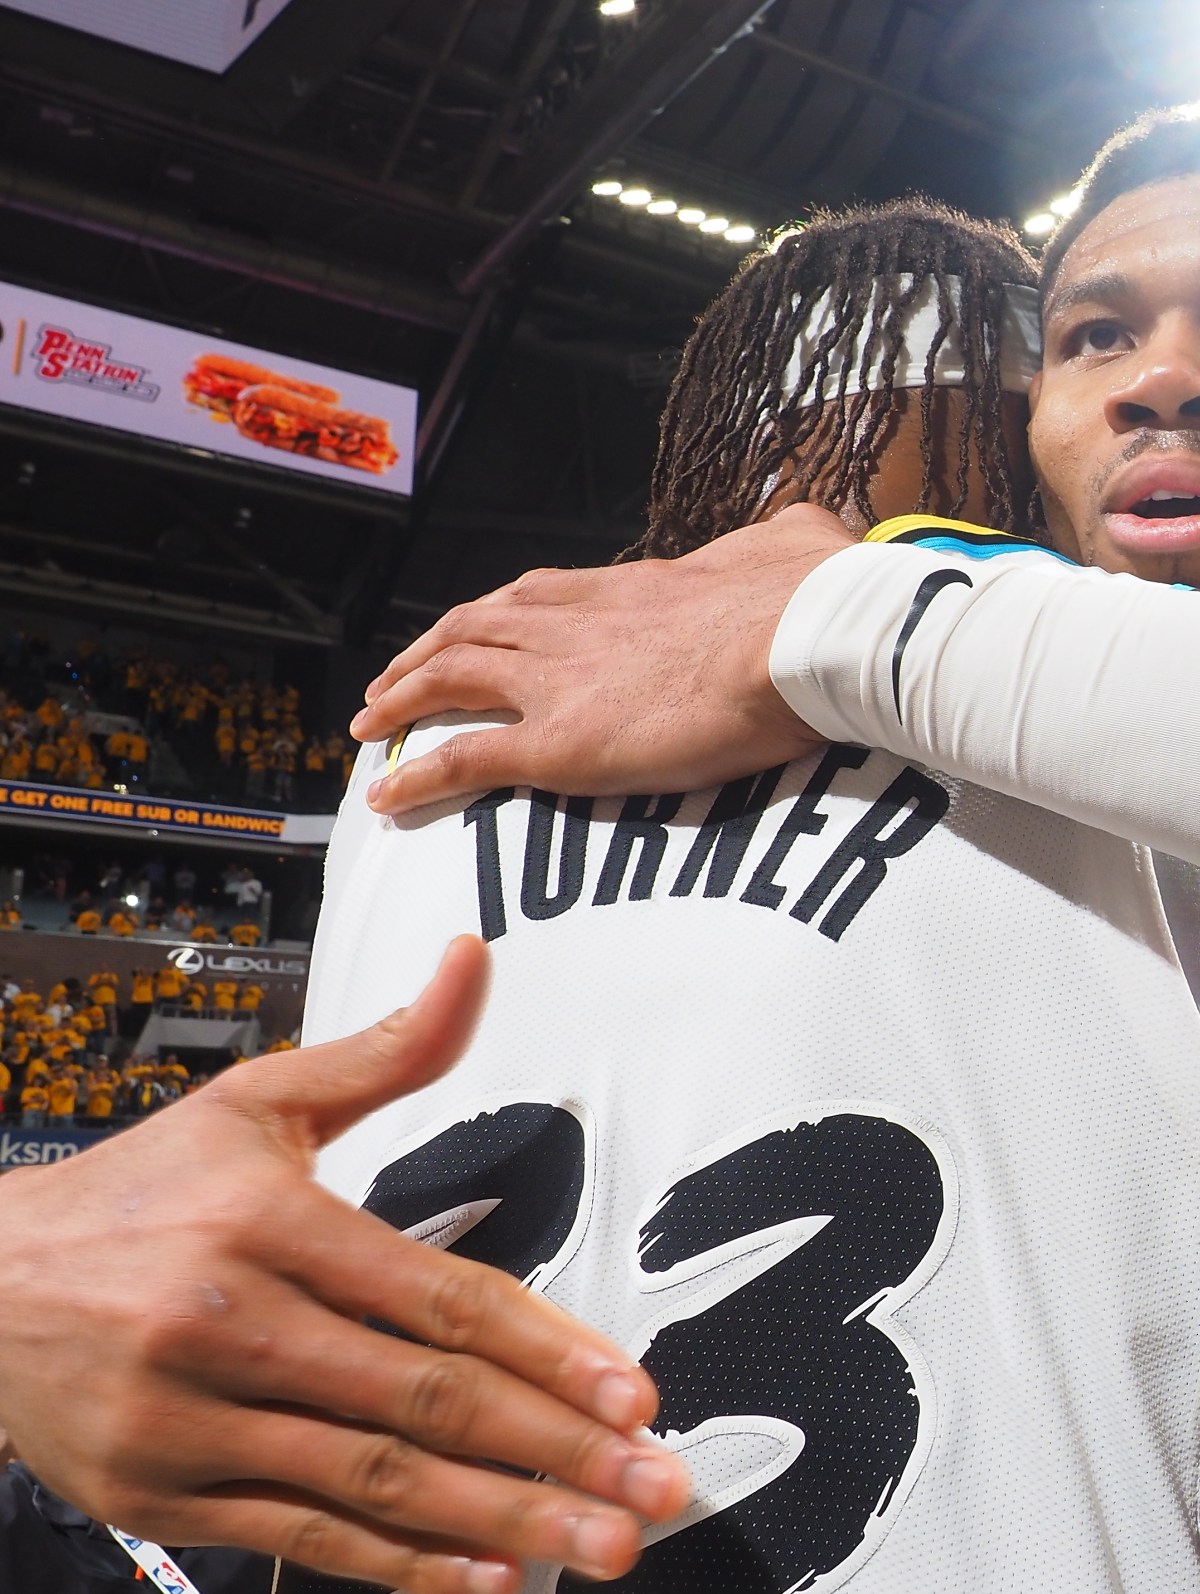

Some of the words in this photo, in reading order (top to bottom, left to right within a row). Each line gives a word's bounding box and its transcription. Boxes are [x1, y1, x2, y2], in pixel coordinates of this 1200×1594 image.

[11, 789, 48, 807] GET
[50, 794, 88, 812] ONE
[91, 799, 134, 817] FREE
[136, 804, 171, 821] SUB
[174, 808, 199, 825] OR
[463, 741, 950, 943] TURNER
[206, 954, 306, 975] LEXUS
